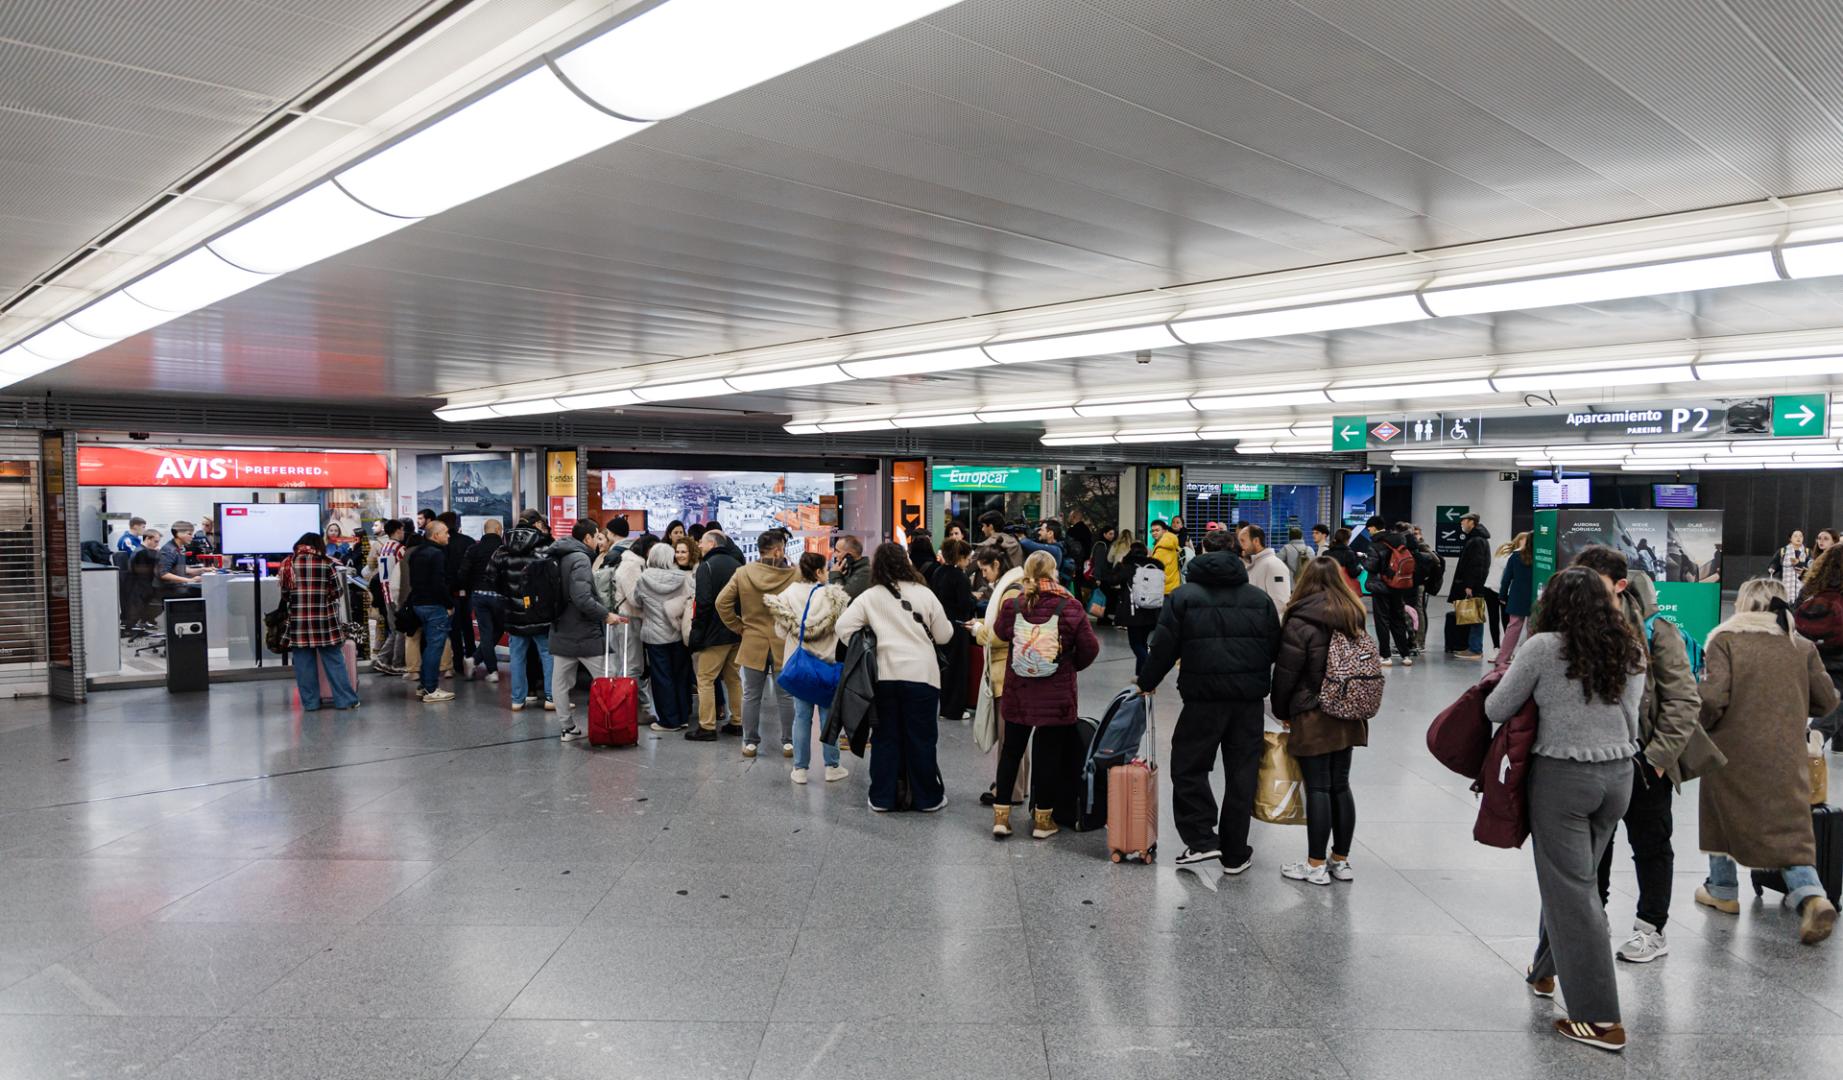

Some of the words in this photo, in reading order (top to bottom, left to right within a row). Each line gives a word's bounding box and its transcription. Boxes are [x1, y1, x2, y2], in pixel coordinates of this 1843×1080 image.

[1566, 410, 1662, 426] Aparcamiento
[1671, 407, 1710, 433] P2
[1627, 426, 1662, 434] PARKING
[155, 457, 228, 480] AVIS
[245, 465, 322, 475] PREFERRED
[949, 469, 1009, 487] Europcar
[1186, 483, 1221, 494] terprise
